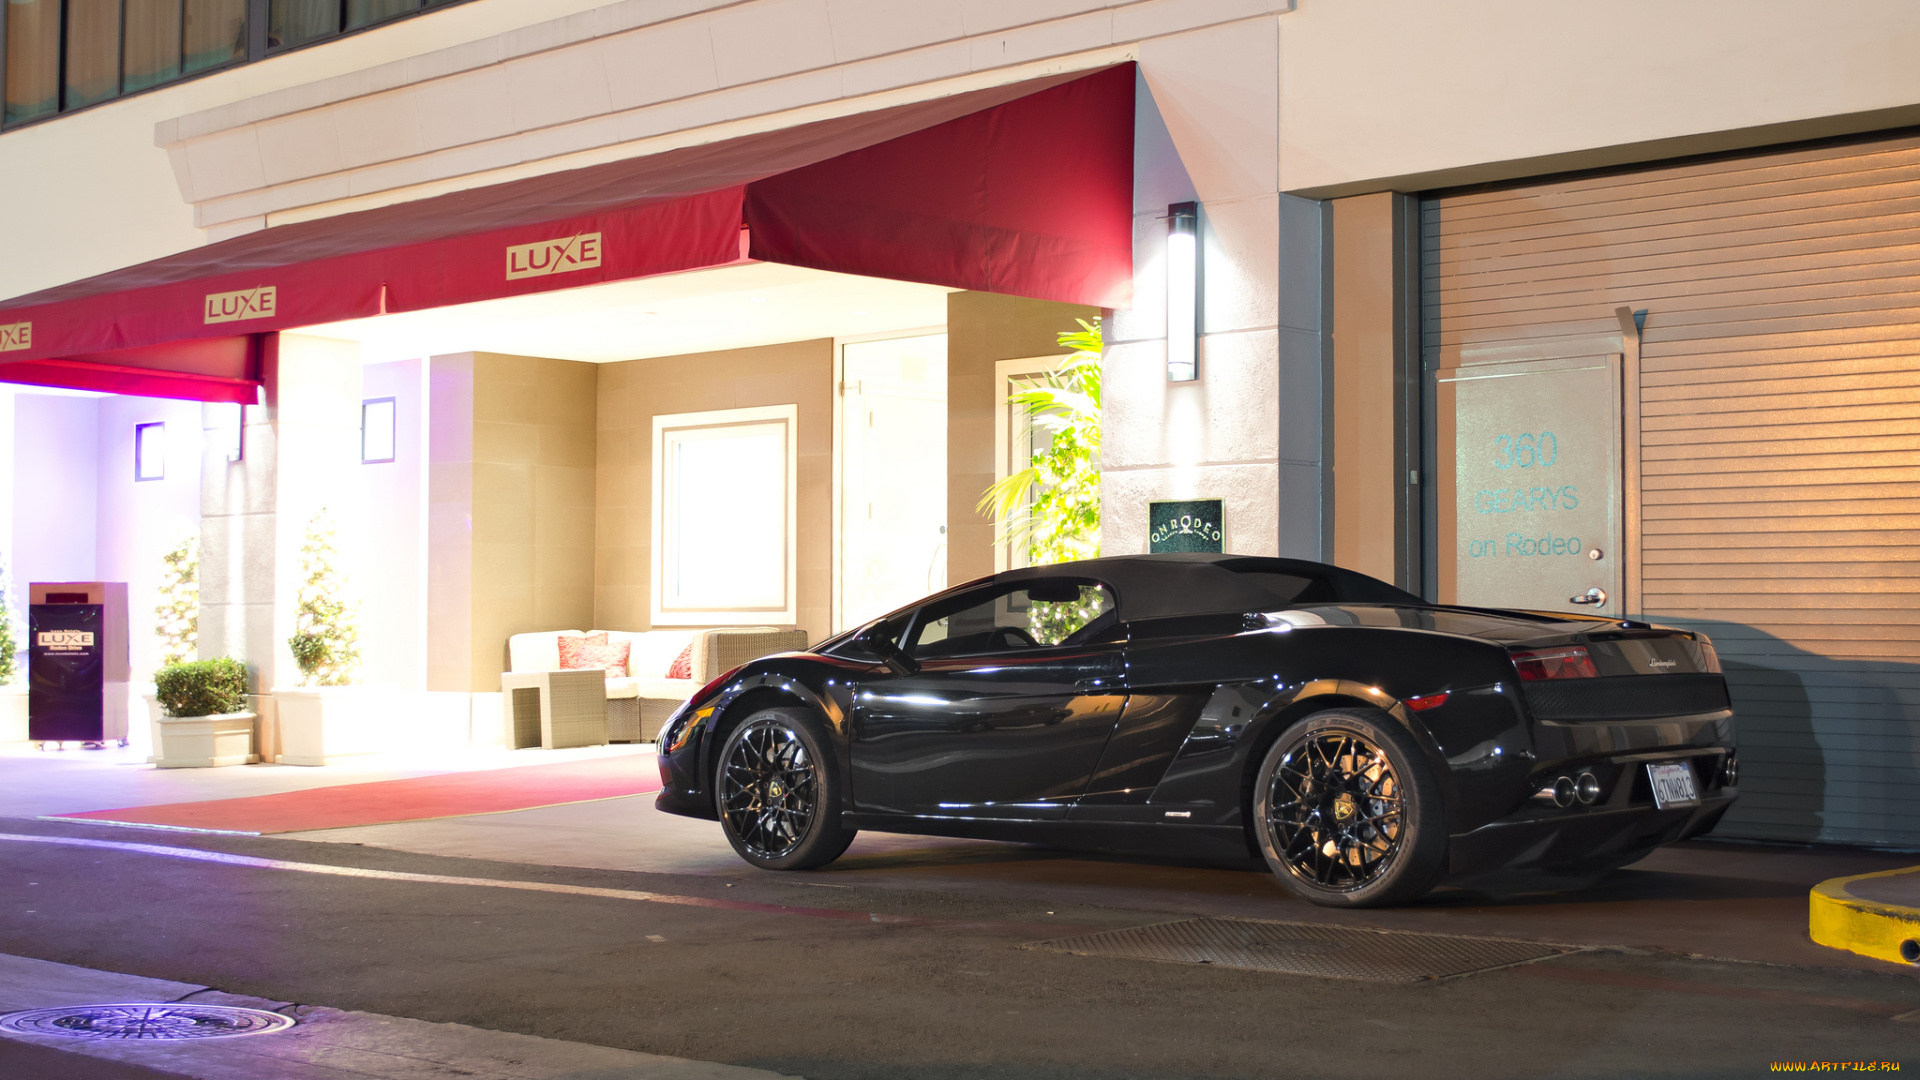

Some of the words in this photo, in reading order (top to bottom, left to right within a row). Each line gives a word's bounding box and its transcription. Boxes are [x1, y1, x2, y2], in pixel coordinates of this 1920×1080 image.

[511, 230, 598, 273] LUXE
[208, 284, 274, 319] LUXE
[0, 320, 30, 350] XE
[1494, 431, 1558, 470] 360
[1474, 485, 1579, 515] GEARYS
[1468, 539, 1497, 558] on
[1506, 532, 1582, 557] Rodeo
[41, 632, 92, 645] LUXE
[1658, 776, 1696, 801] 6TNW813
